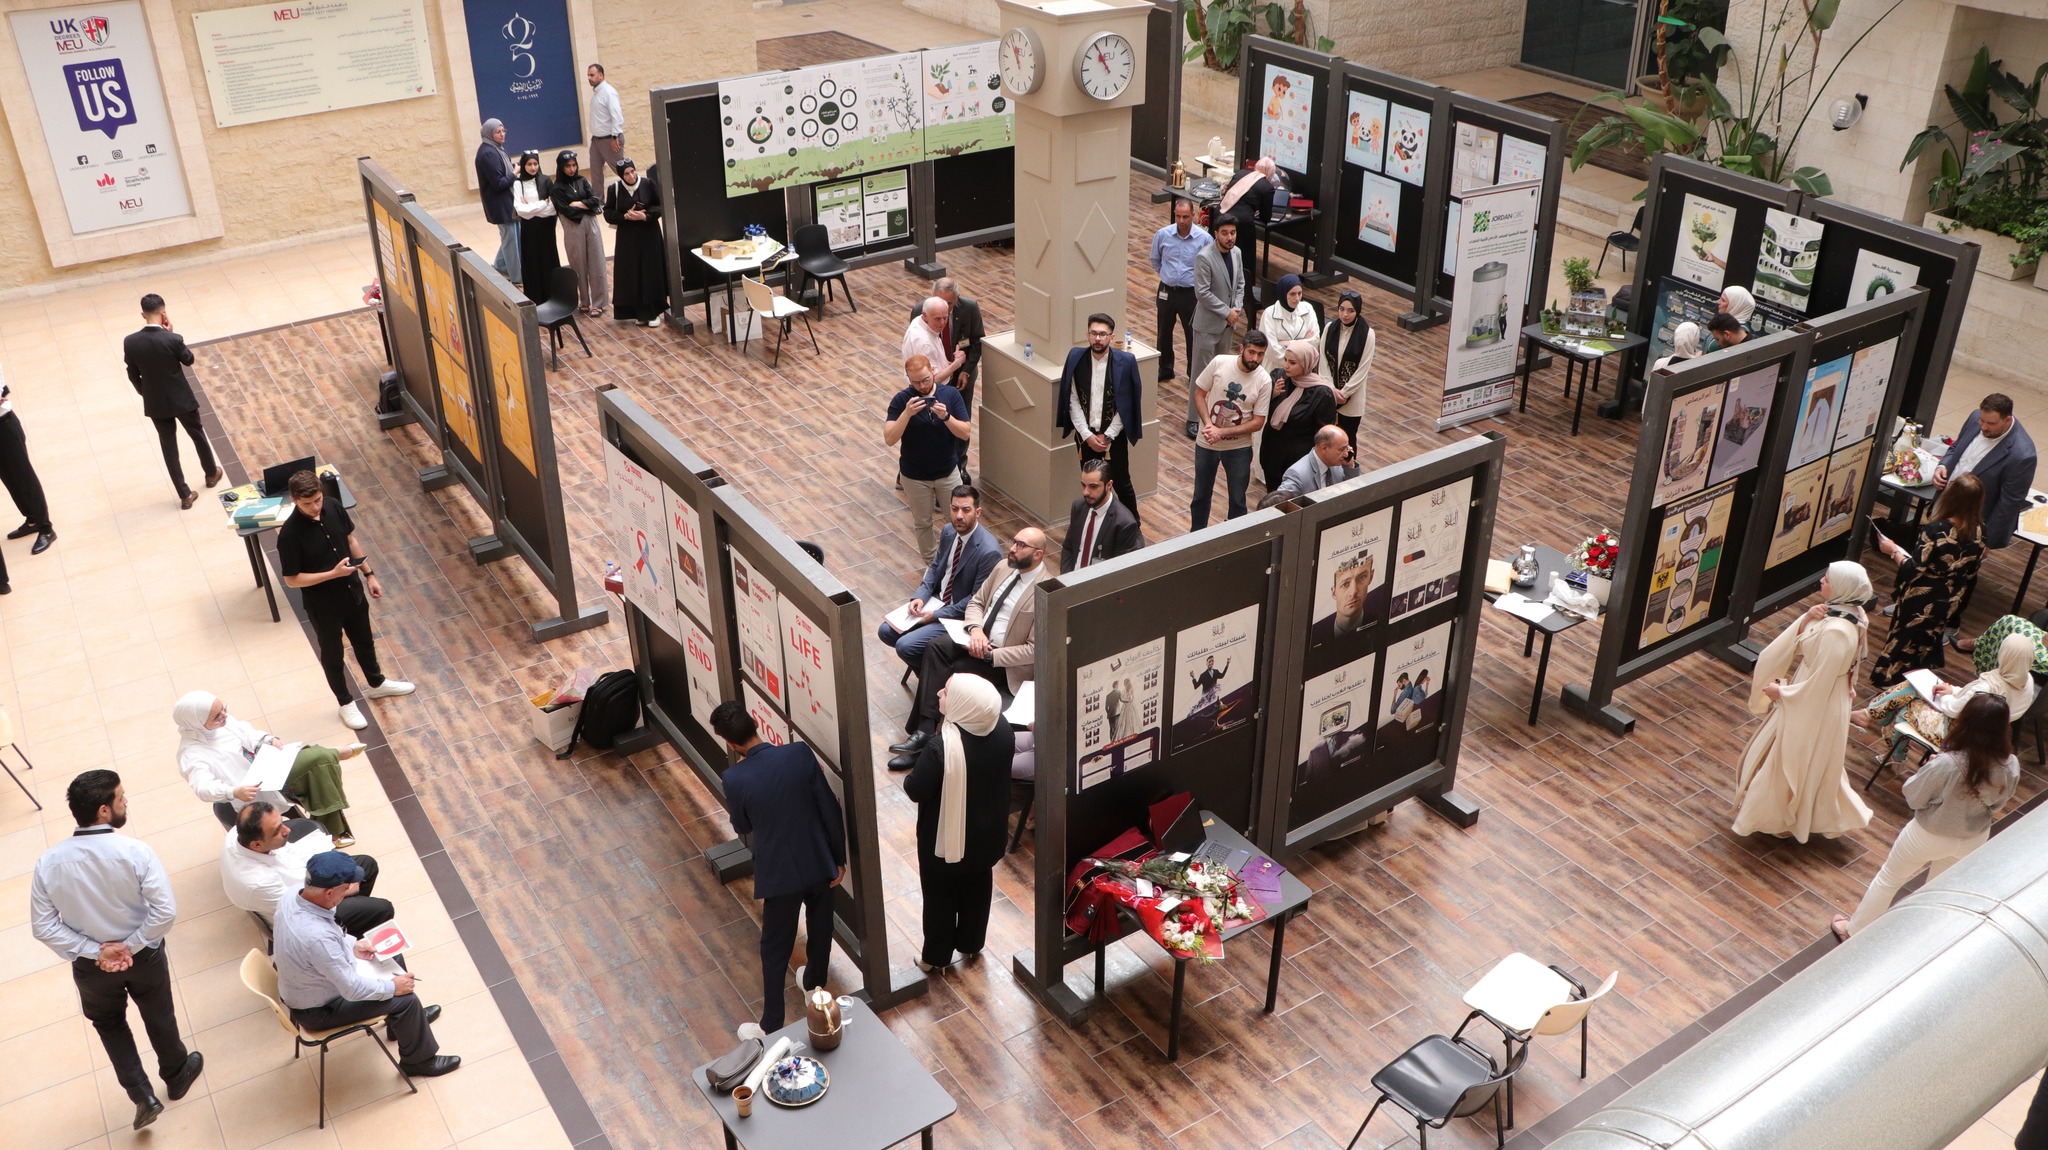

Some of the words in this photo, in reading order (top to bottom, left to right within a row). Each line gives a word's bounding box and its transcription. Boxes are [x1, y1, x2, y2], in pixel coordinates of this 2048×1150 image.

[273, 7, 300, 21] MEU
[50, 18, 79, 34] UK
[56, 38, 84, 51] MEU
[75, 66, 116, 82] FOLLOW
[78, 80, 127, 122] US
[125, 175, 151, 183] Strathclyde
[119, 197, 143, 210] MEU
[1491, 213, 1513, 222] JORDAN
[1685, 393, 1705, 406] الرصاص
[674, 512, 699, 549] KILL
[1364, 536, 1379, 544] ضحية
[751, 578, 772, 601] Guideline
[1215, 640, 1229, 648] لبيك
[1229, 632, 1246, 643] شبيك
[687, 637, 712, 672] END
[790, 626, 821, 670] LIFE
[1142, 645, 1162, 657] تكاليف
[1187, 647, 1208, 658] طلباتك
[751, 709, 784, 746] STOP
